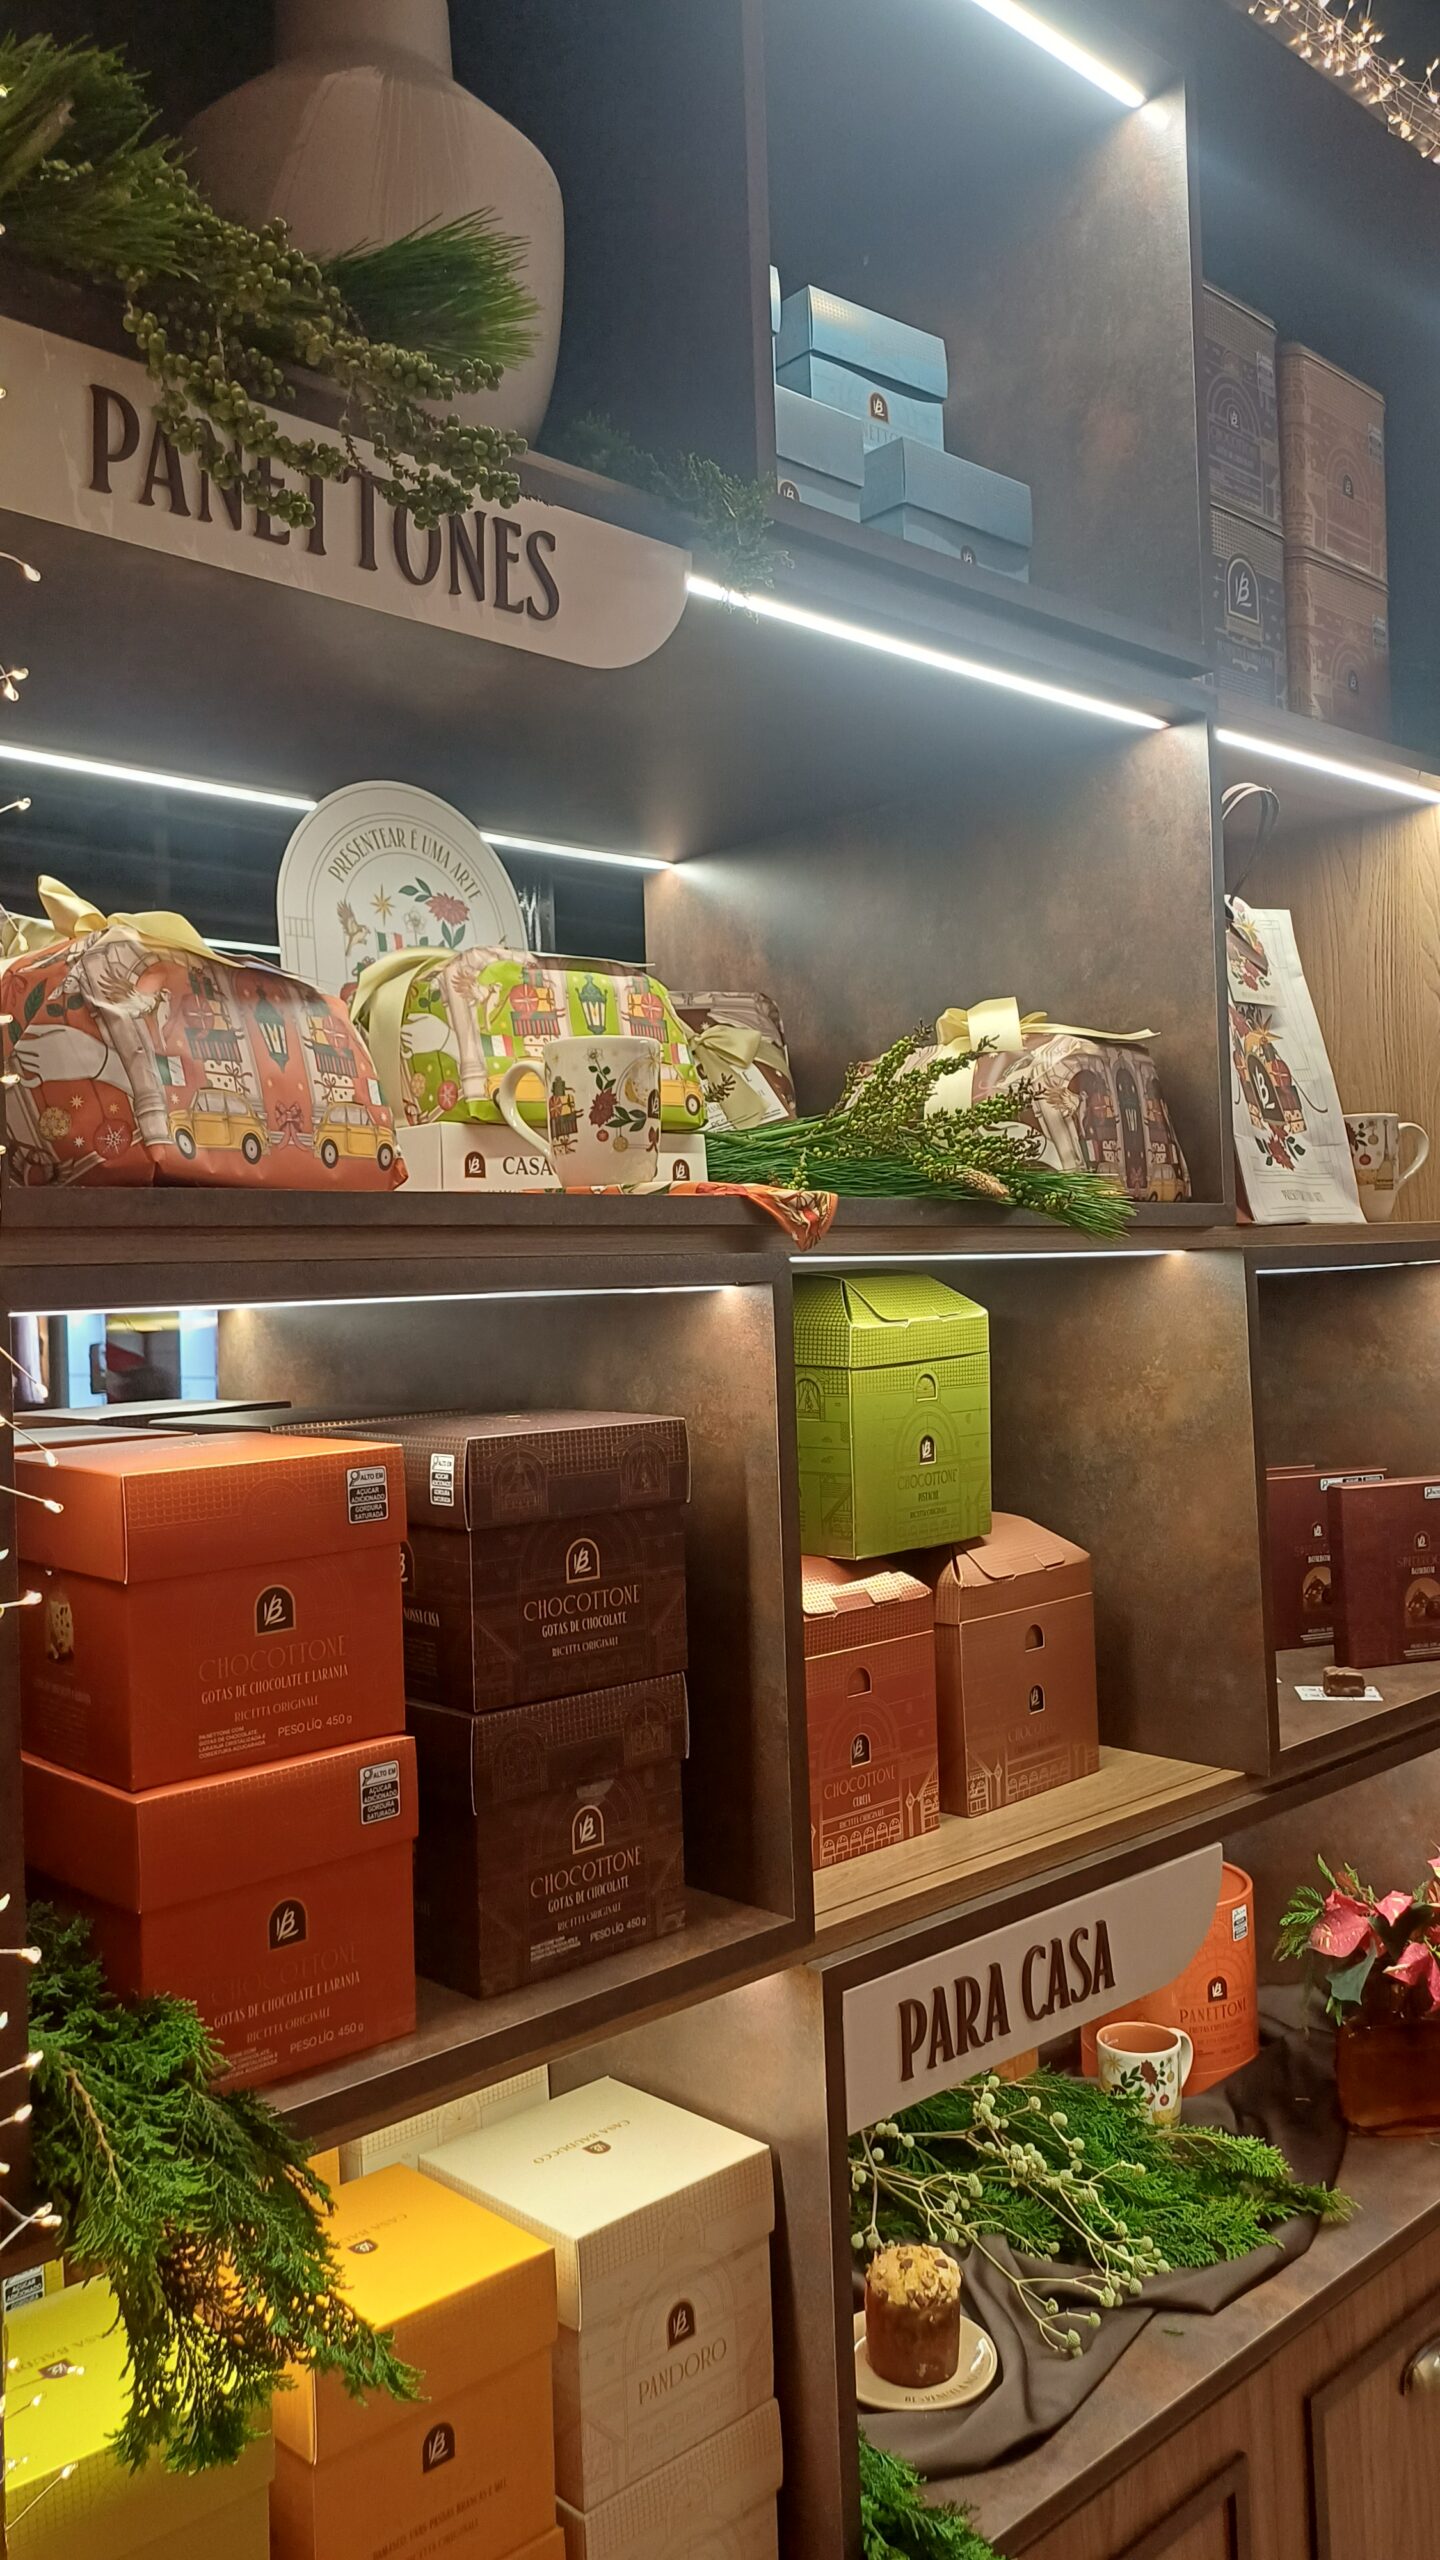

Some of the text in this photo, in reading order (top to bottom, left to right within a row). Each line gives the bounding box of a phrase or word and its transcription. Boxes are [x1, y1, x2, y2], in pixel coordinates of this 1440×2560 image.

[331, 826, 483, 903] PRESENTEAR É UMA ARTE
[502, 1156, 554, 1176] CASA
[897, 1468, 959, 1491] CHOCOTTONE
[355, 1504, 382, 1513] GORDURA
[523, 1584, 640, 1622] CHOCOTTONE
[541, 1611, 628, 1639] GOTAS DE CHOCOLATE
[199, 1635, 347, 1683] CHOCOTTONE
[201, 1663, 349, 1705] GOTAS DE CHOCOLATE E LARANJA
[234, 1695, 319, 1724] RICETTA ORIGINALE
[277, 1722, 305, 1738] PESO
[326, 1713, 346, 1728] 450
[346, 1714, 353, 1725] g
[823, 1764, 896, 1800] CHOCOTTONE
[530, 1845, 643, 1899] CHOCOTTONE
[548, 1875, 630, 1913] GOTAS DE CHOCOLATE
[589, 1926, 611, 1943] PESO
[214, 2007, 246, 2030] GOTAS
[248, 2002, 260, 2019] DE
[261, 1983, 315, 2014] CHOCOLATE
[324, 1970, 361, 1993] LARANJA
[897, 1919, 1117, 2083] PARA CASA
[1179, 1997, 1248, 2024] PANETTONE
[289, 2036, 318, 2055] PESO
[337, 2022, 357, 2037] 450
[357, 2022, 365, 2034] g
[638, 2336, 727, 2405] PANDORO
